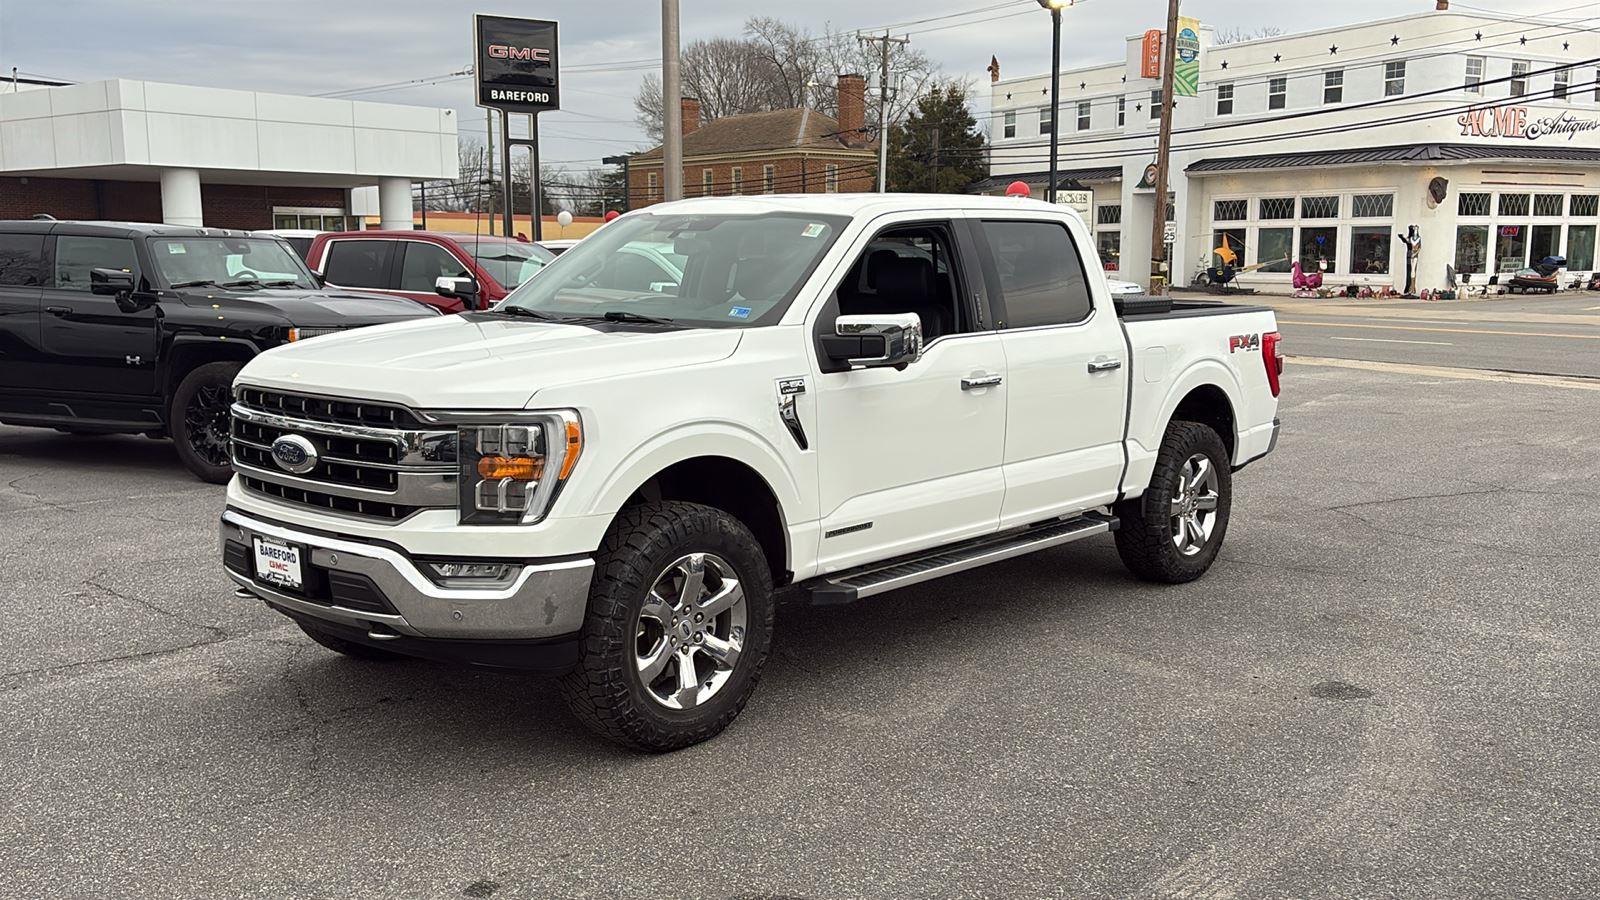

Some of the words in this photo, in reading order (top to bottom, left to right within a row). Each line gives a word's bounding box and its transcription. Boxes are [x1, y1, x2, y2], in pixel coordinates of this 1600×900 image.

[488, 44, 550, 61] GMC
[1150, 33, 1159, 74] ACME
[491, 89, 549, 102] BAREFORD
[1457, 104, 1528, 138] ACME
[1164, 232, 1175, 241] 25
[1229, 333, 1260, 353] FX4
[260, 545, 297, 564] BAREFORD
[269, 560, 289, 572] GMC
